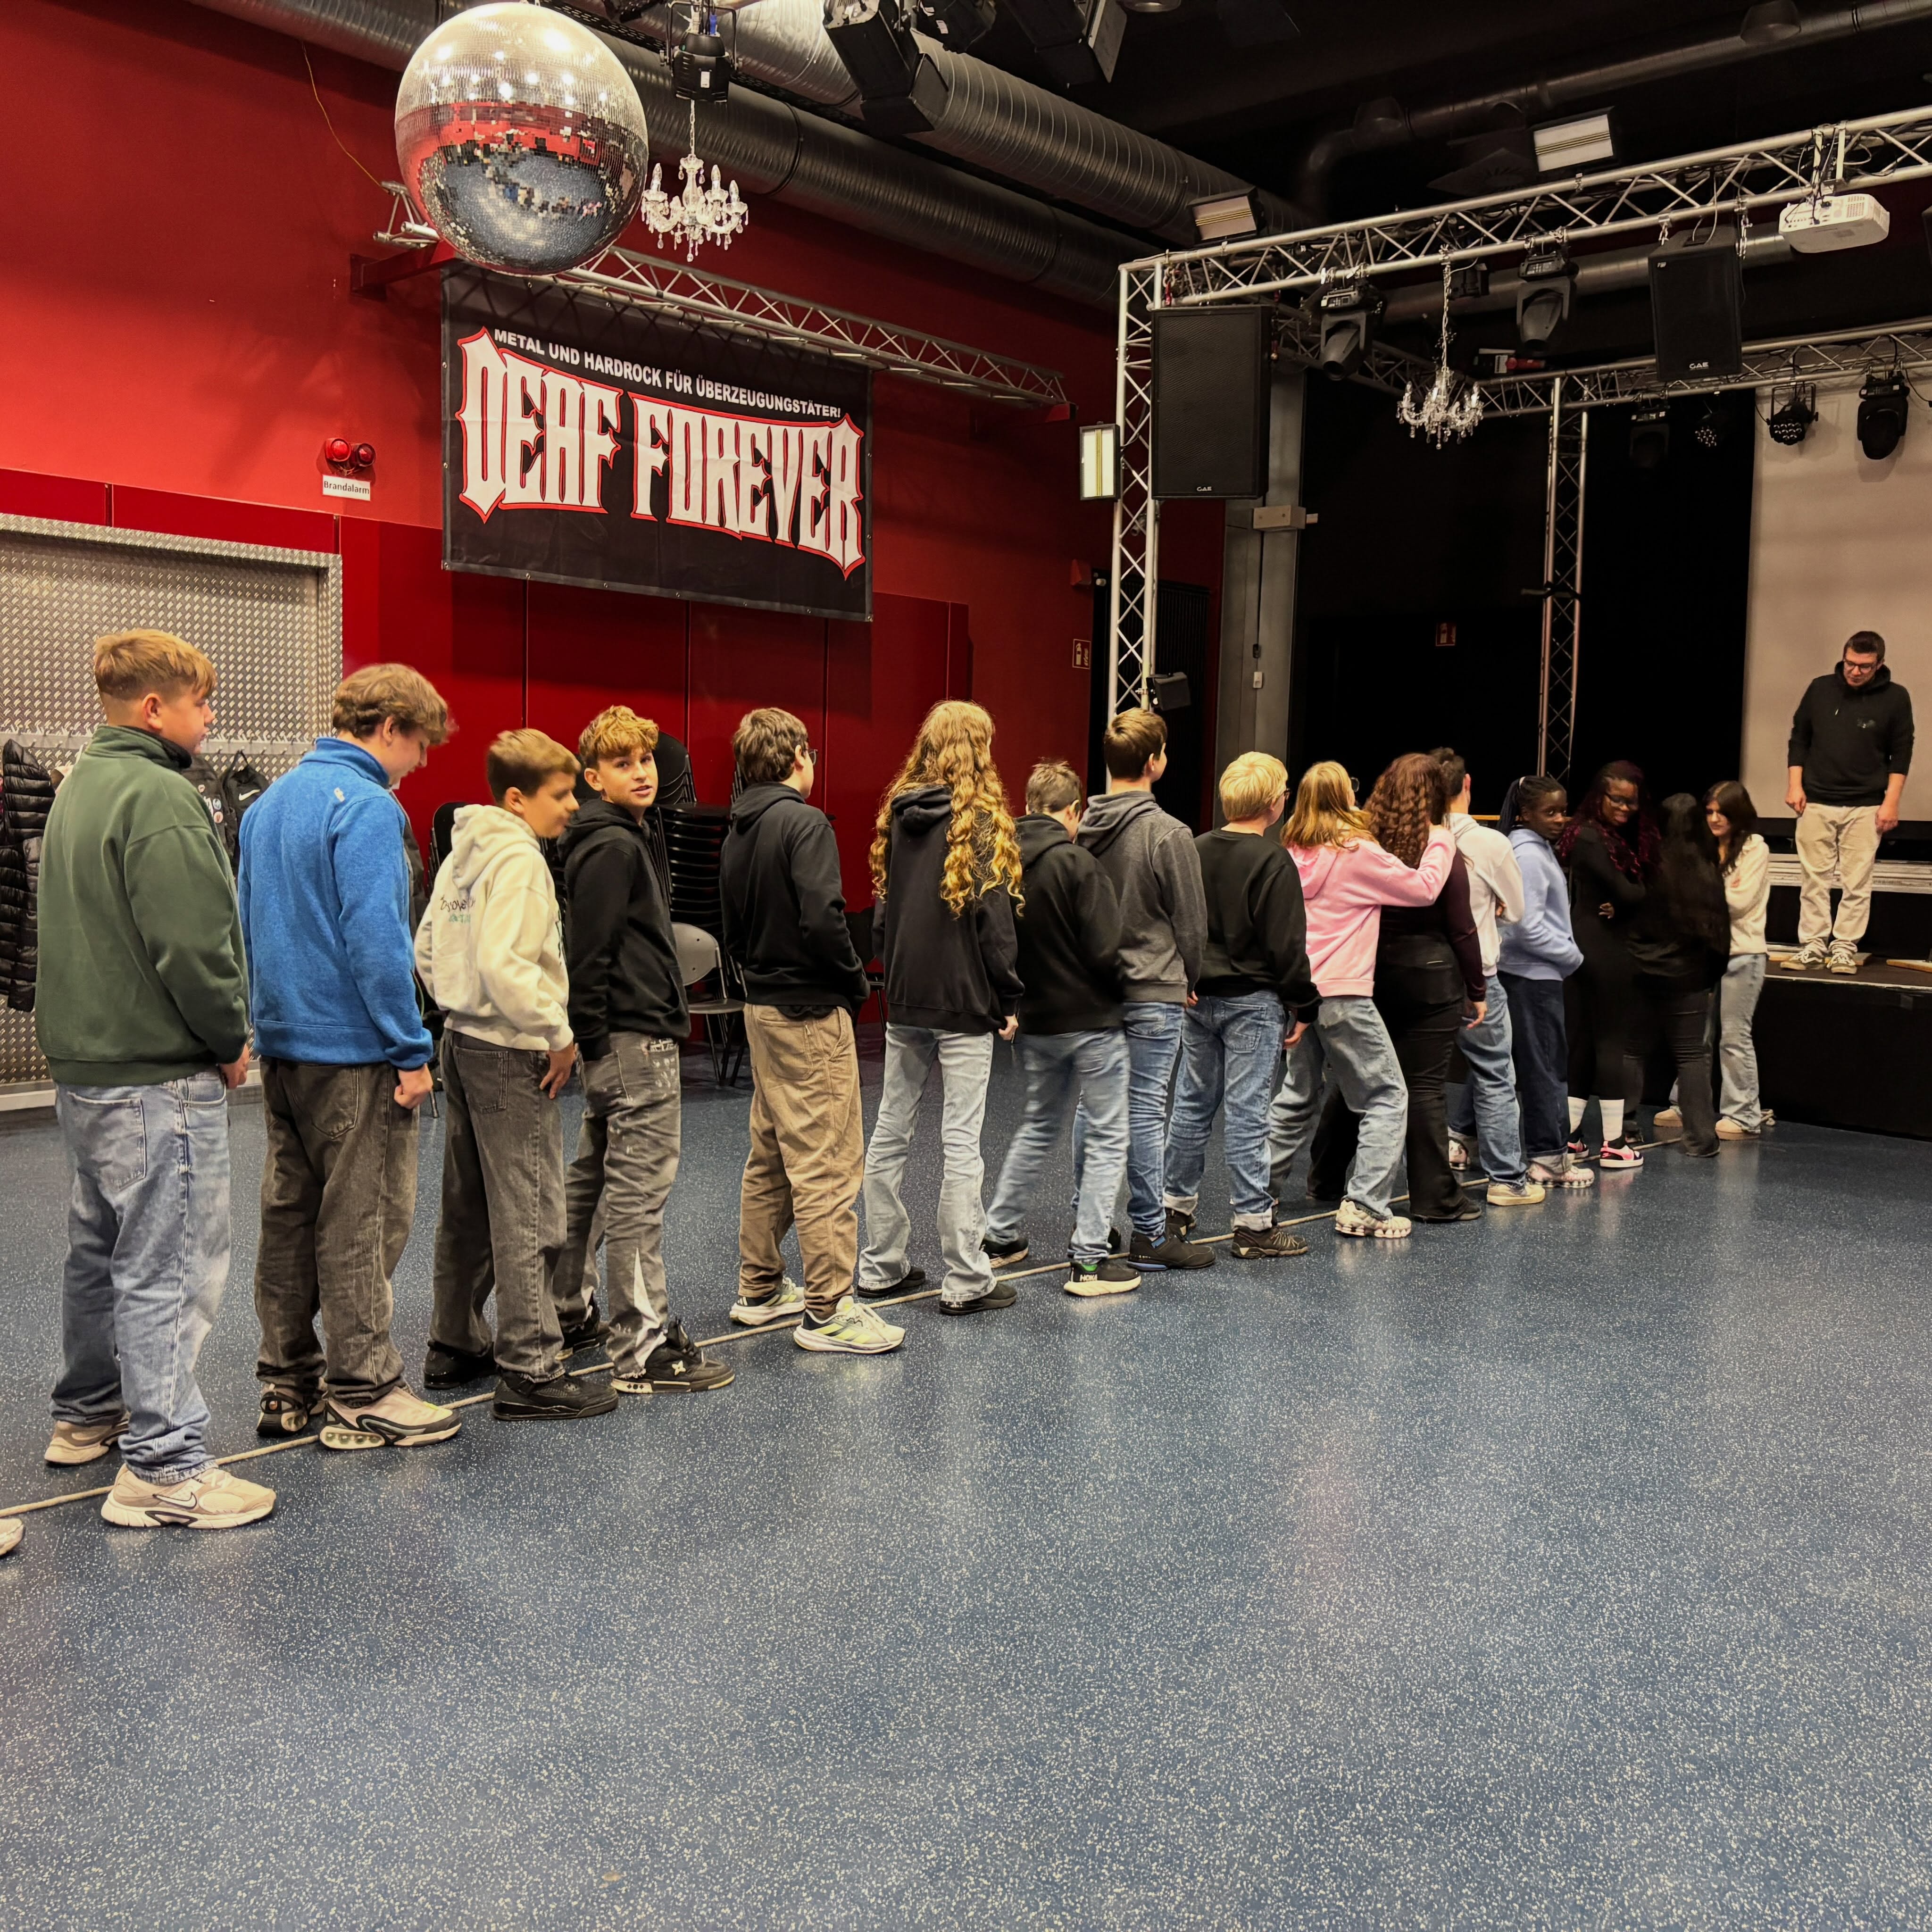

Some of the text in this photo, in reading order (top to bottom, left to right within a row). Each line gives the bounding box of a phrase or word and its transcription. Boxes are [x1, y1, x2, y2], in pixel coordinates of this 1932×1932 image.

[494, 329, 841, 418] METAL UND HARDROCK FÜR ÜBERZEUGUNGSTÄTER!
[324, 481, 369, 494] Brandalarm
[456, 326, 865, 580] DEAF FOREVER
